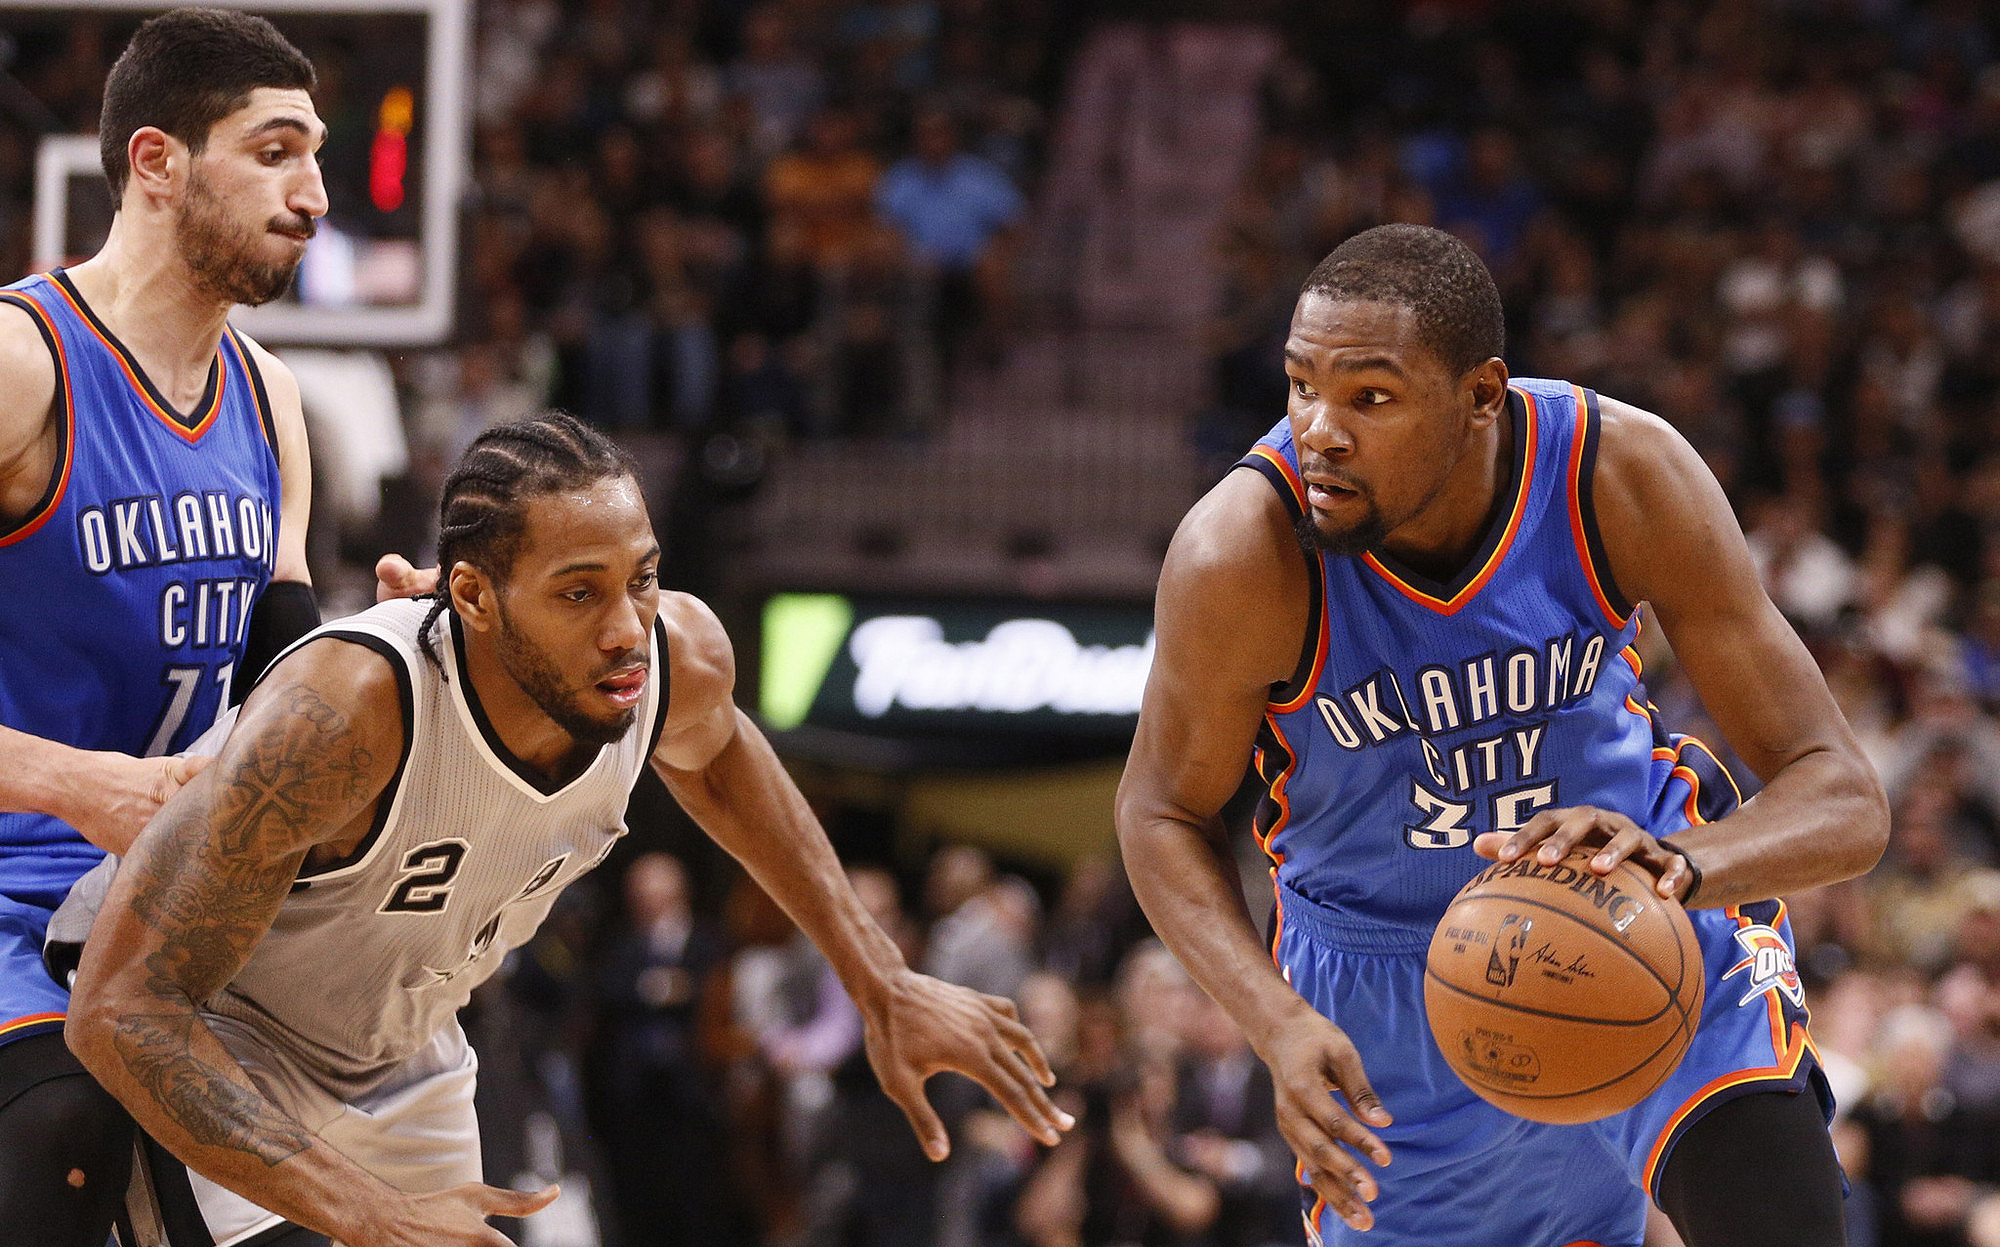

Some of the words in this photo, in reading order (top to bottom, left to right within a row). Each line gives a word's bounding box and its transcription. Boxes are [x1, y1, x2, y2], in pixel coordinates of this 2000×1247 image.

[160, 578, 257, 649] CITY
[1314, 632, 1606, 751] OKLAHOMA
[1420, 725, 1544, 793] CITY
[1407, 780, 1557, 850] 35
[376, 837, 472, 915] 2
[1465, 859, 1645, 932] SPALDING
